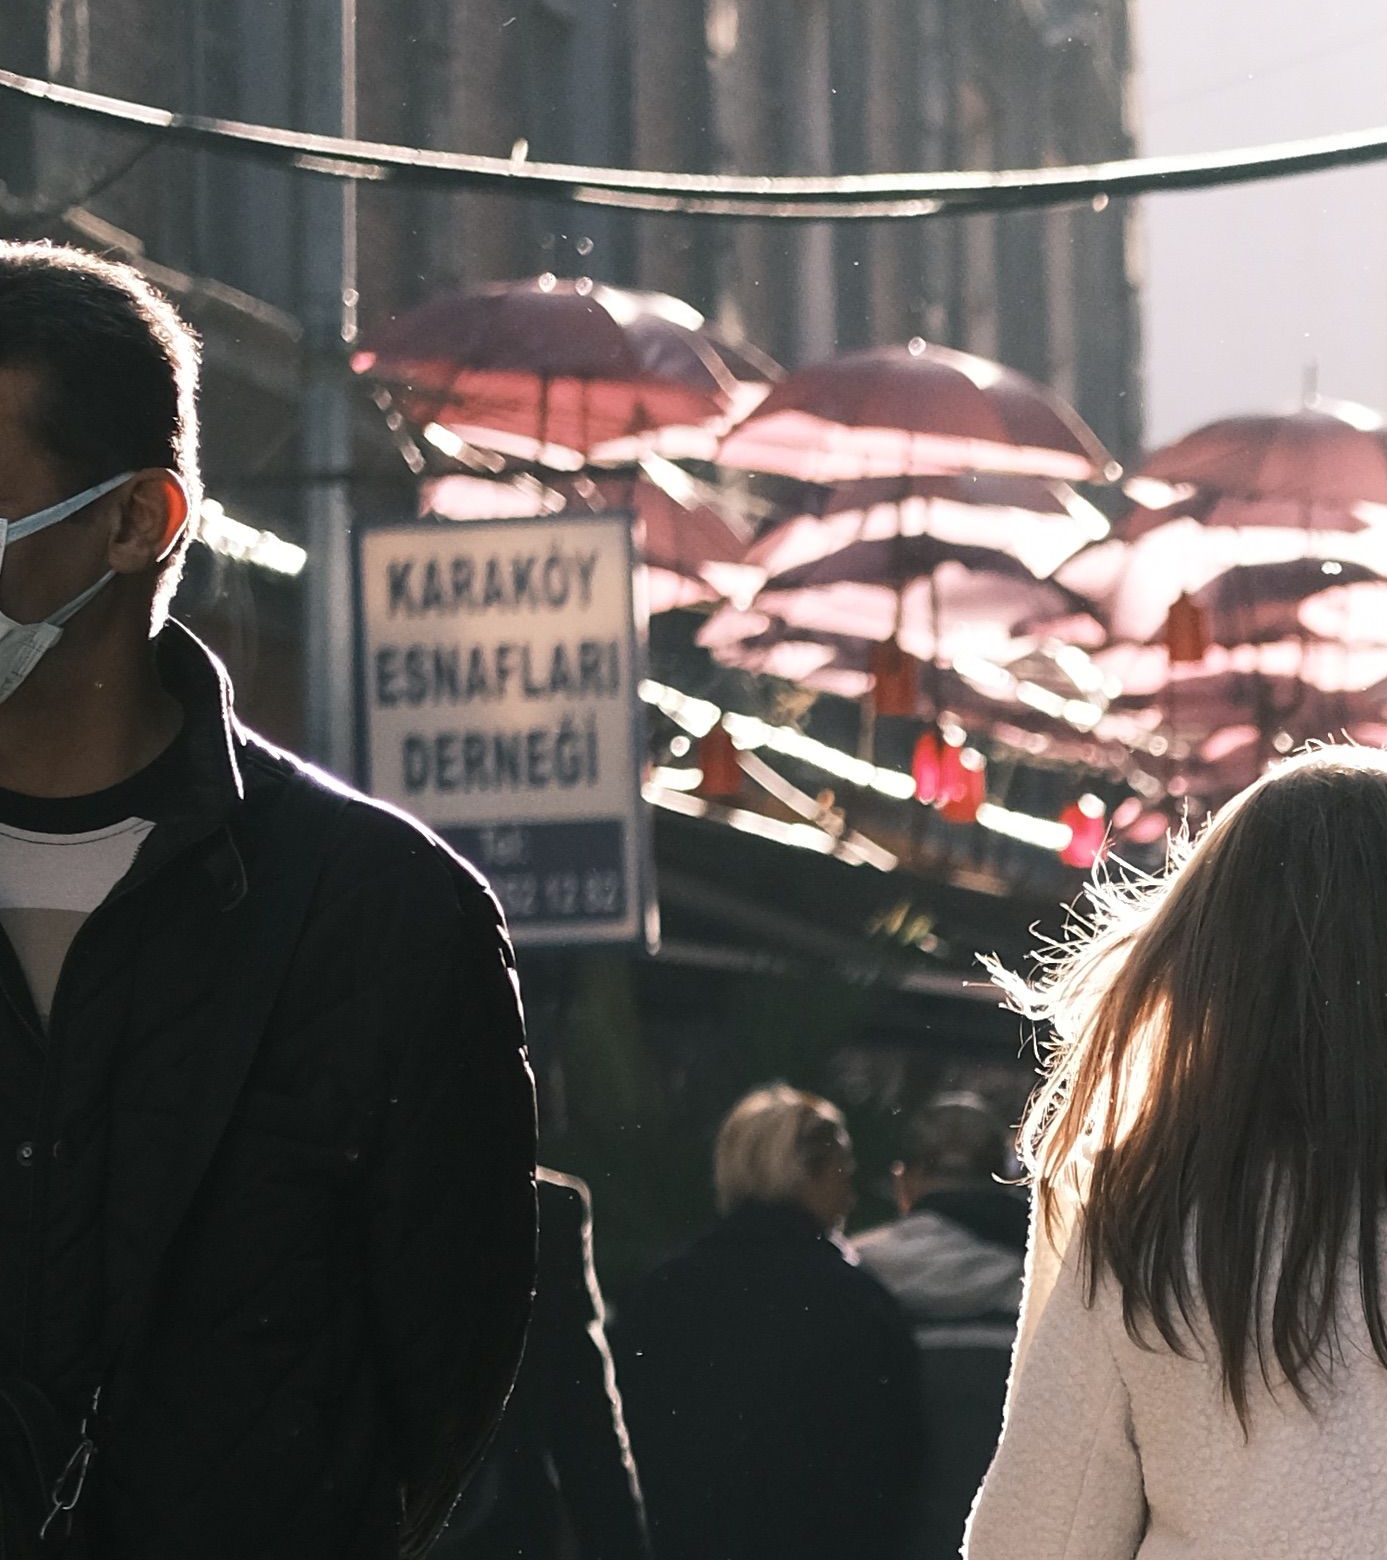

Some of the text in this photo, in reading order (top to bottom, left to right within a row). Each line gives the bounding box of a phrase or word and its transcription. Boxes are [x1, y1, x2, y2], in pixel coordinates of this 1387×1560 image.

[385, 538, 600, 617] KARAKÖY
[374, 638, 620, 709] ESNAFLARI
[402, 711, 599, 796] DERNEĞİ
